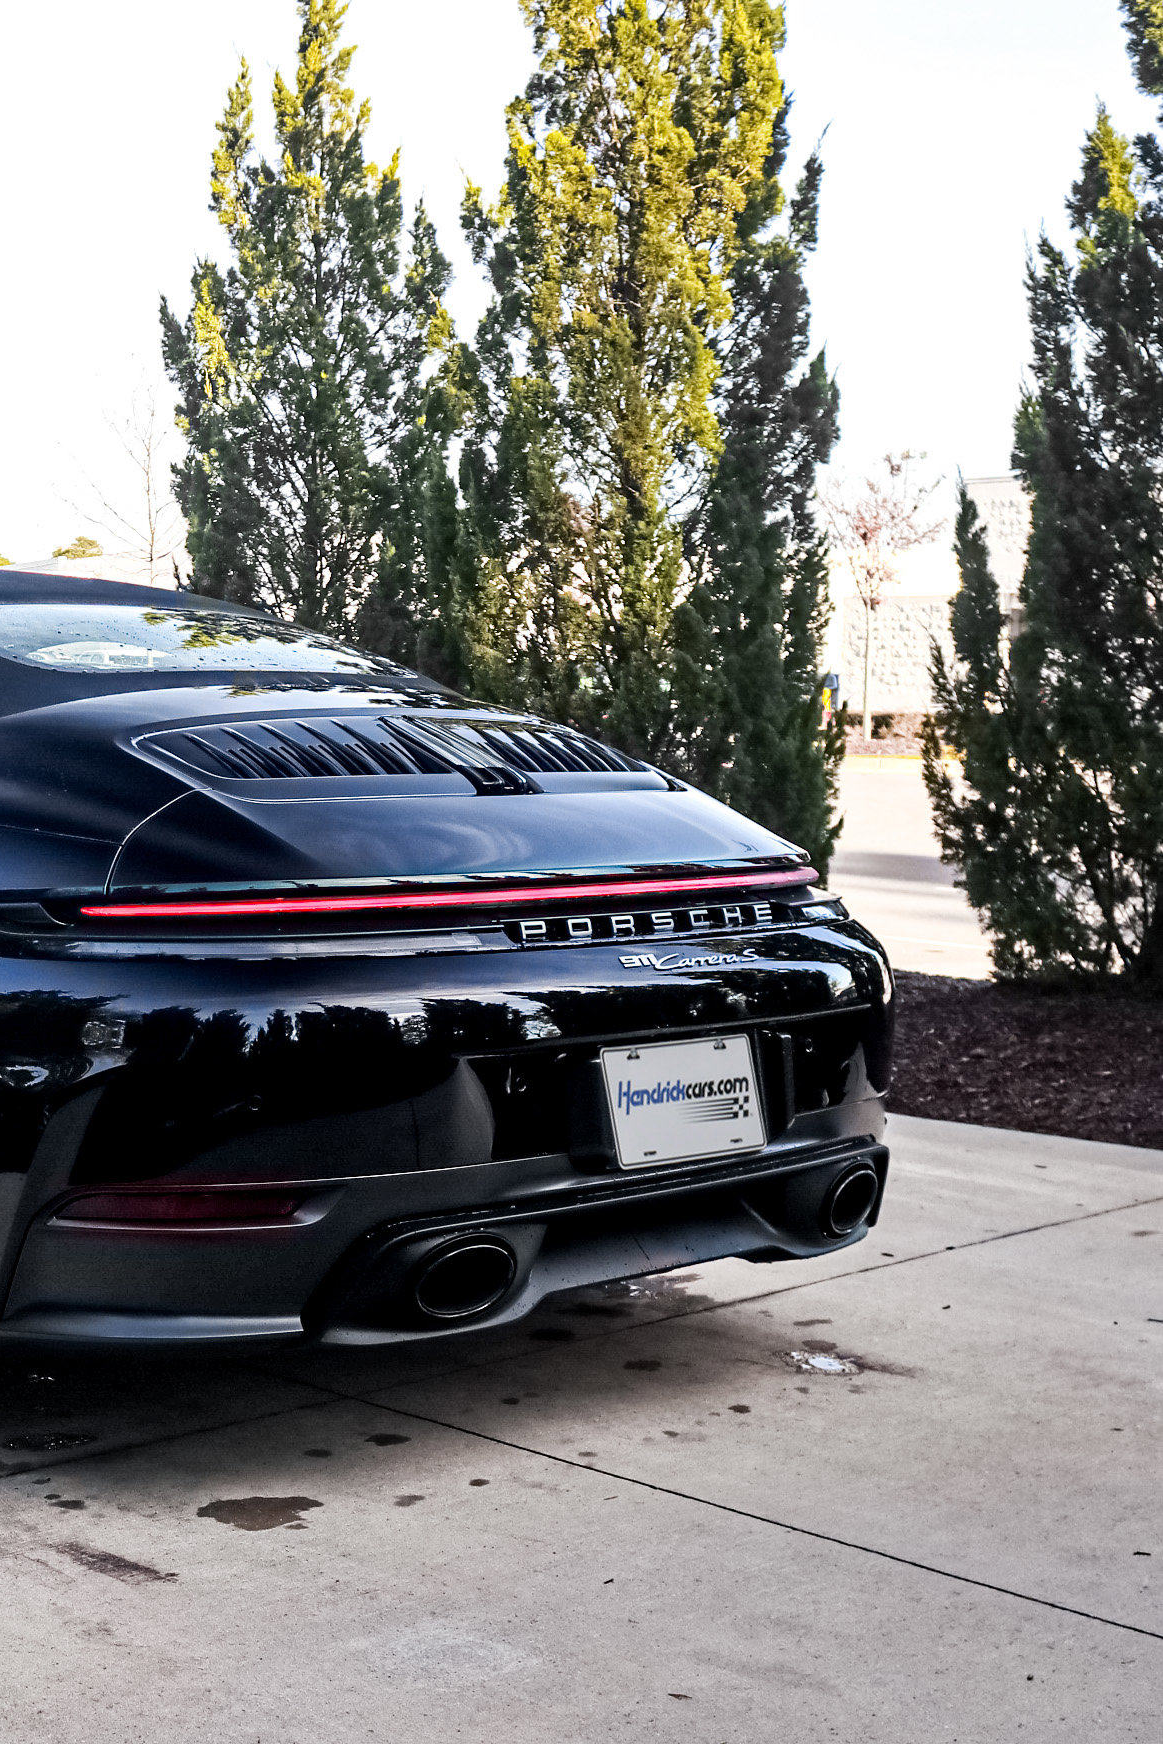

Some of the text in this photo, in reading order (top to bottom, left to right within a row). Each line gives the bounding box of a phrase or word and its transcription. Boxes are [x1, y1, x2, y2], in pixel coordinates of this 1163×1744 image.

[520, 903, 773, 940] PORSCHE
[654, 953, 739, 970] Carrera
[741, 948, 759, 962] S
[617, 1076, 749, 1115] Hendrickcars.com
